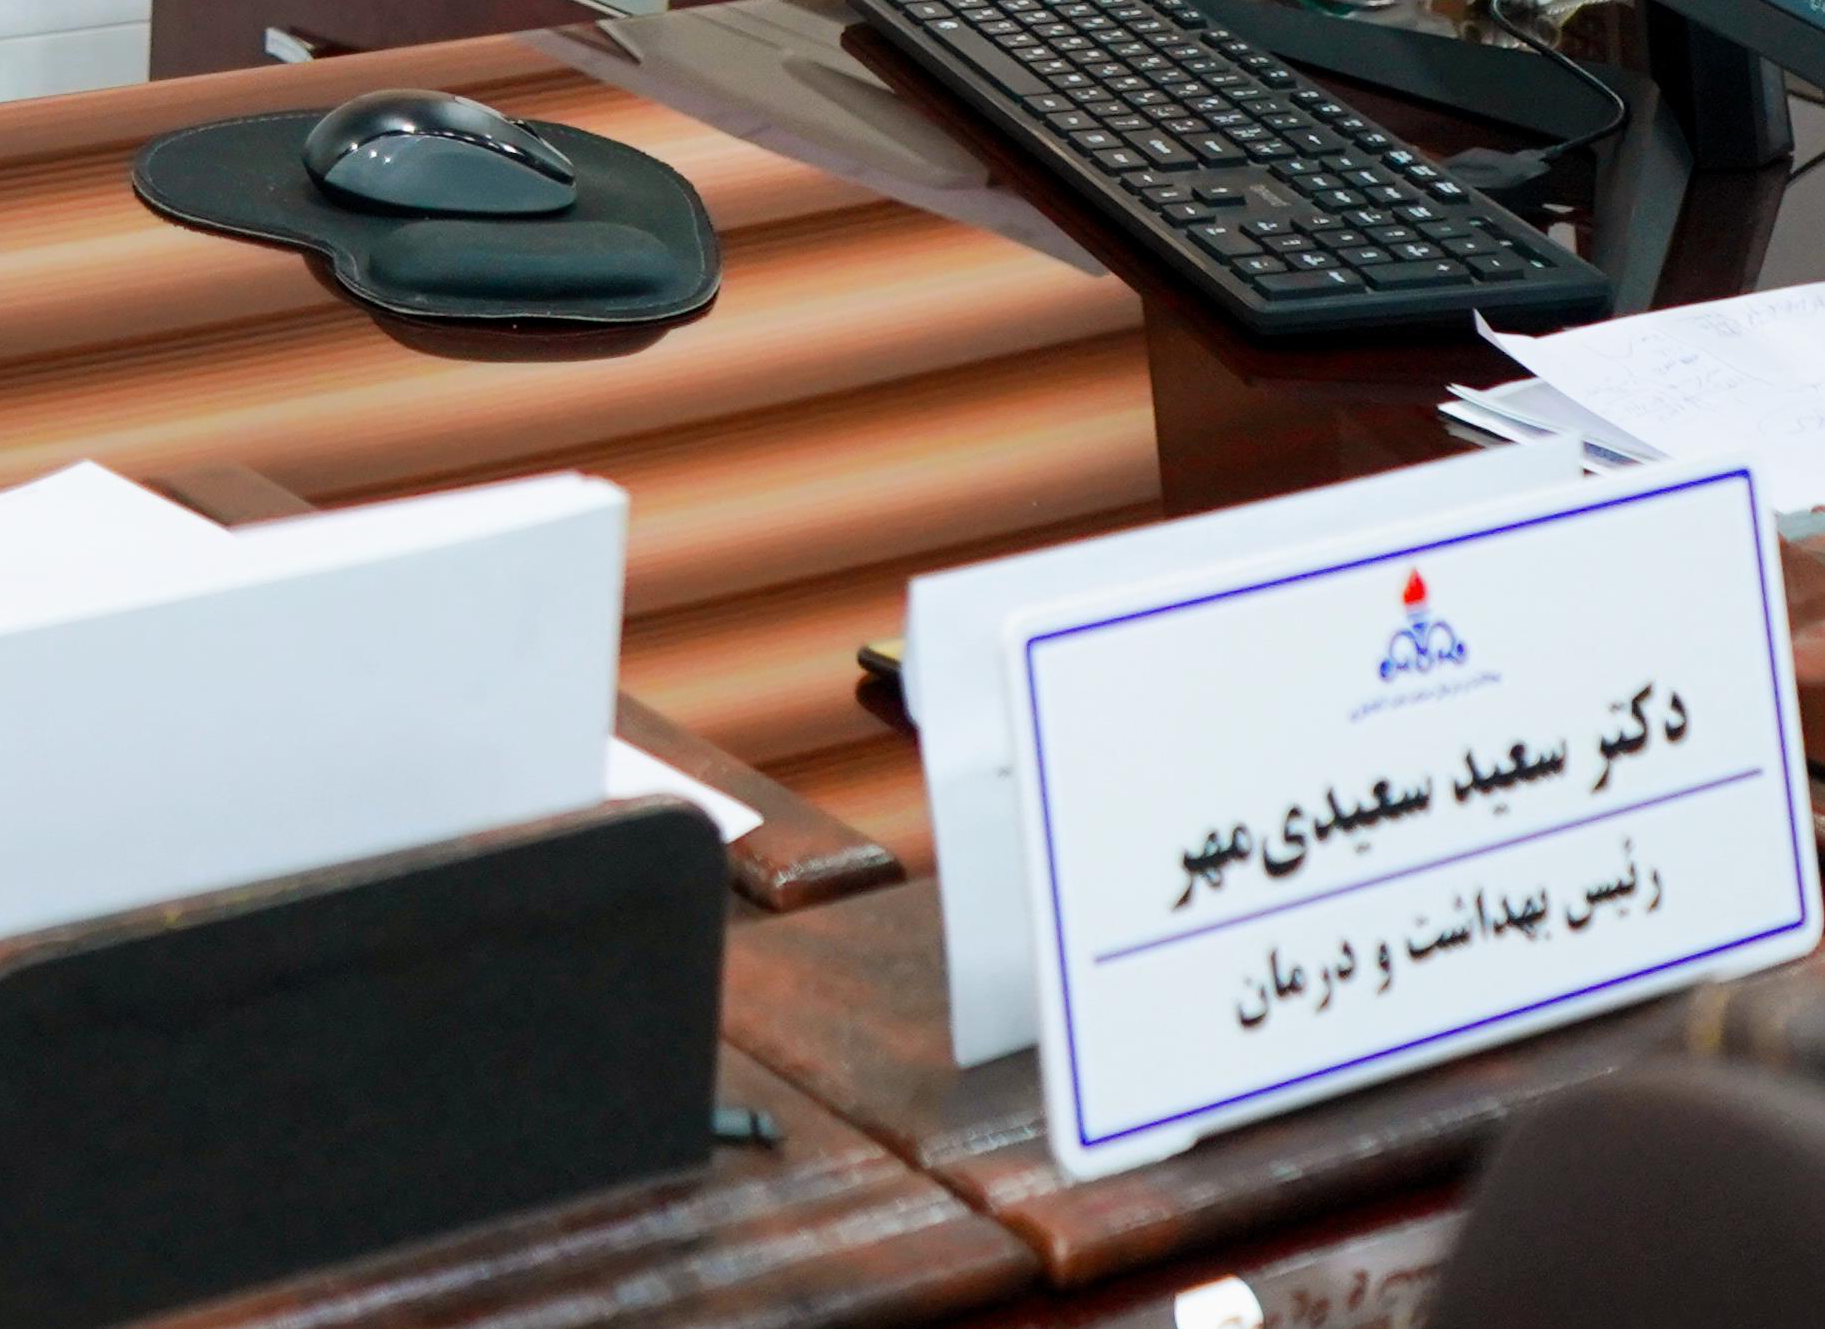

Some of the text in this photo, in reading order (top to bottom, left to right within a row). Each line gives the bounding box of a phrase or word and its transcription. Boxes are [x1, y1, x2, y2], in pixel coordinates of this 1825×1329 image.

[1452, 739, 1568, 816] سعید
[1590, 680, 1690, 793] دکتر
[1234, 838, 1663, 1031] رئیس بهداشت و درمان
